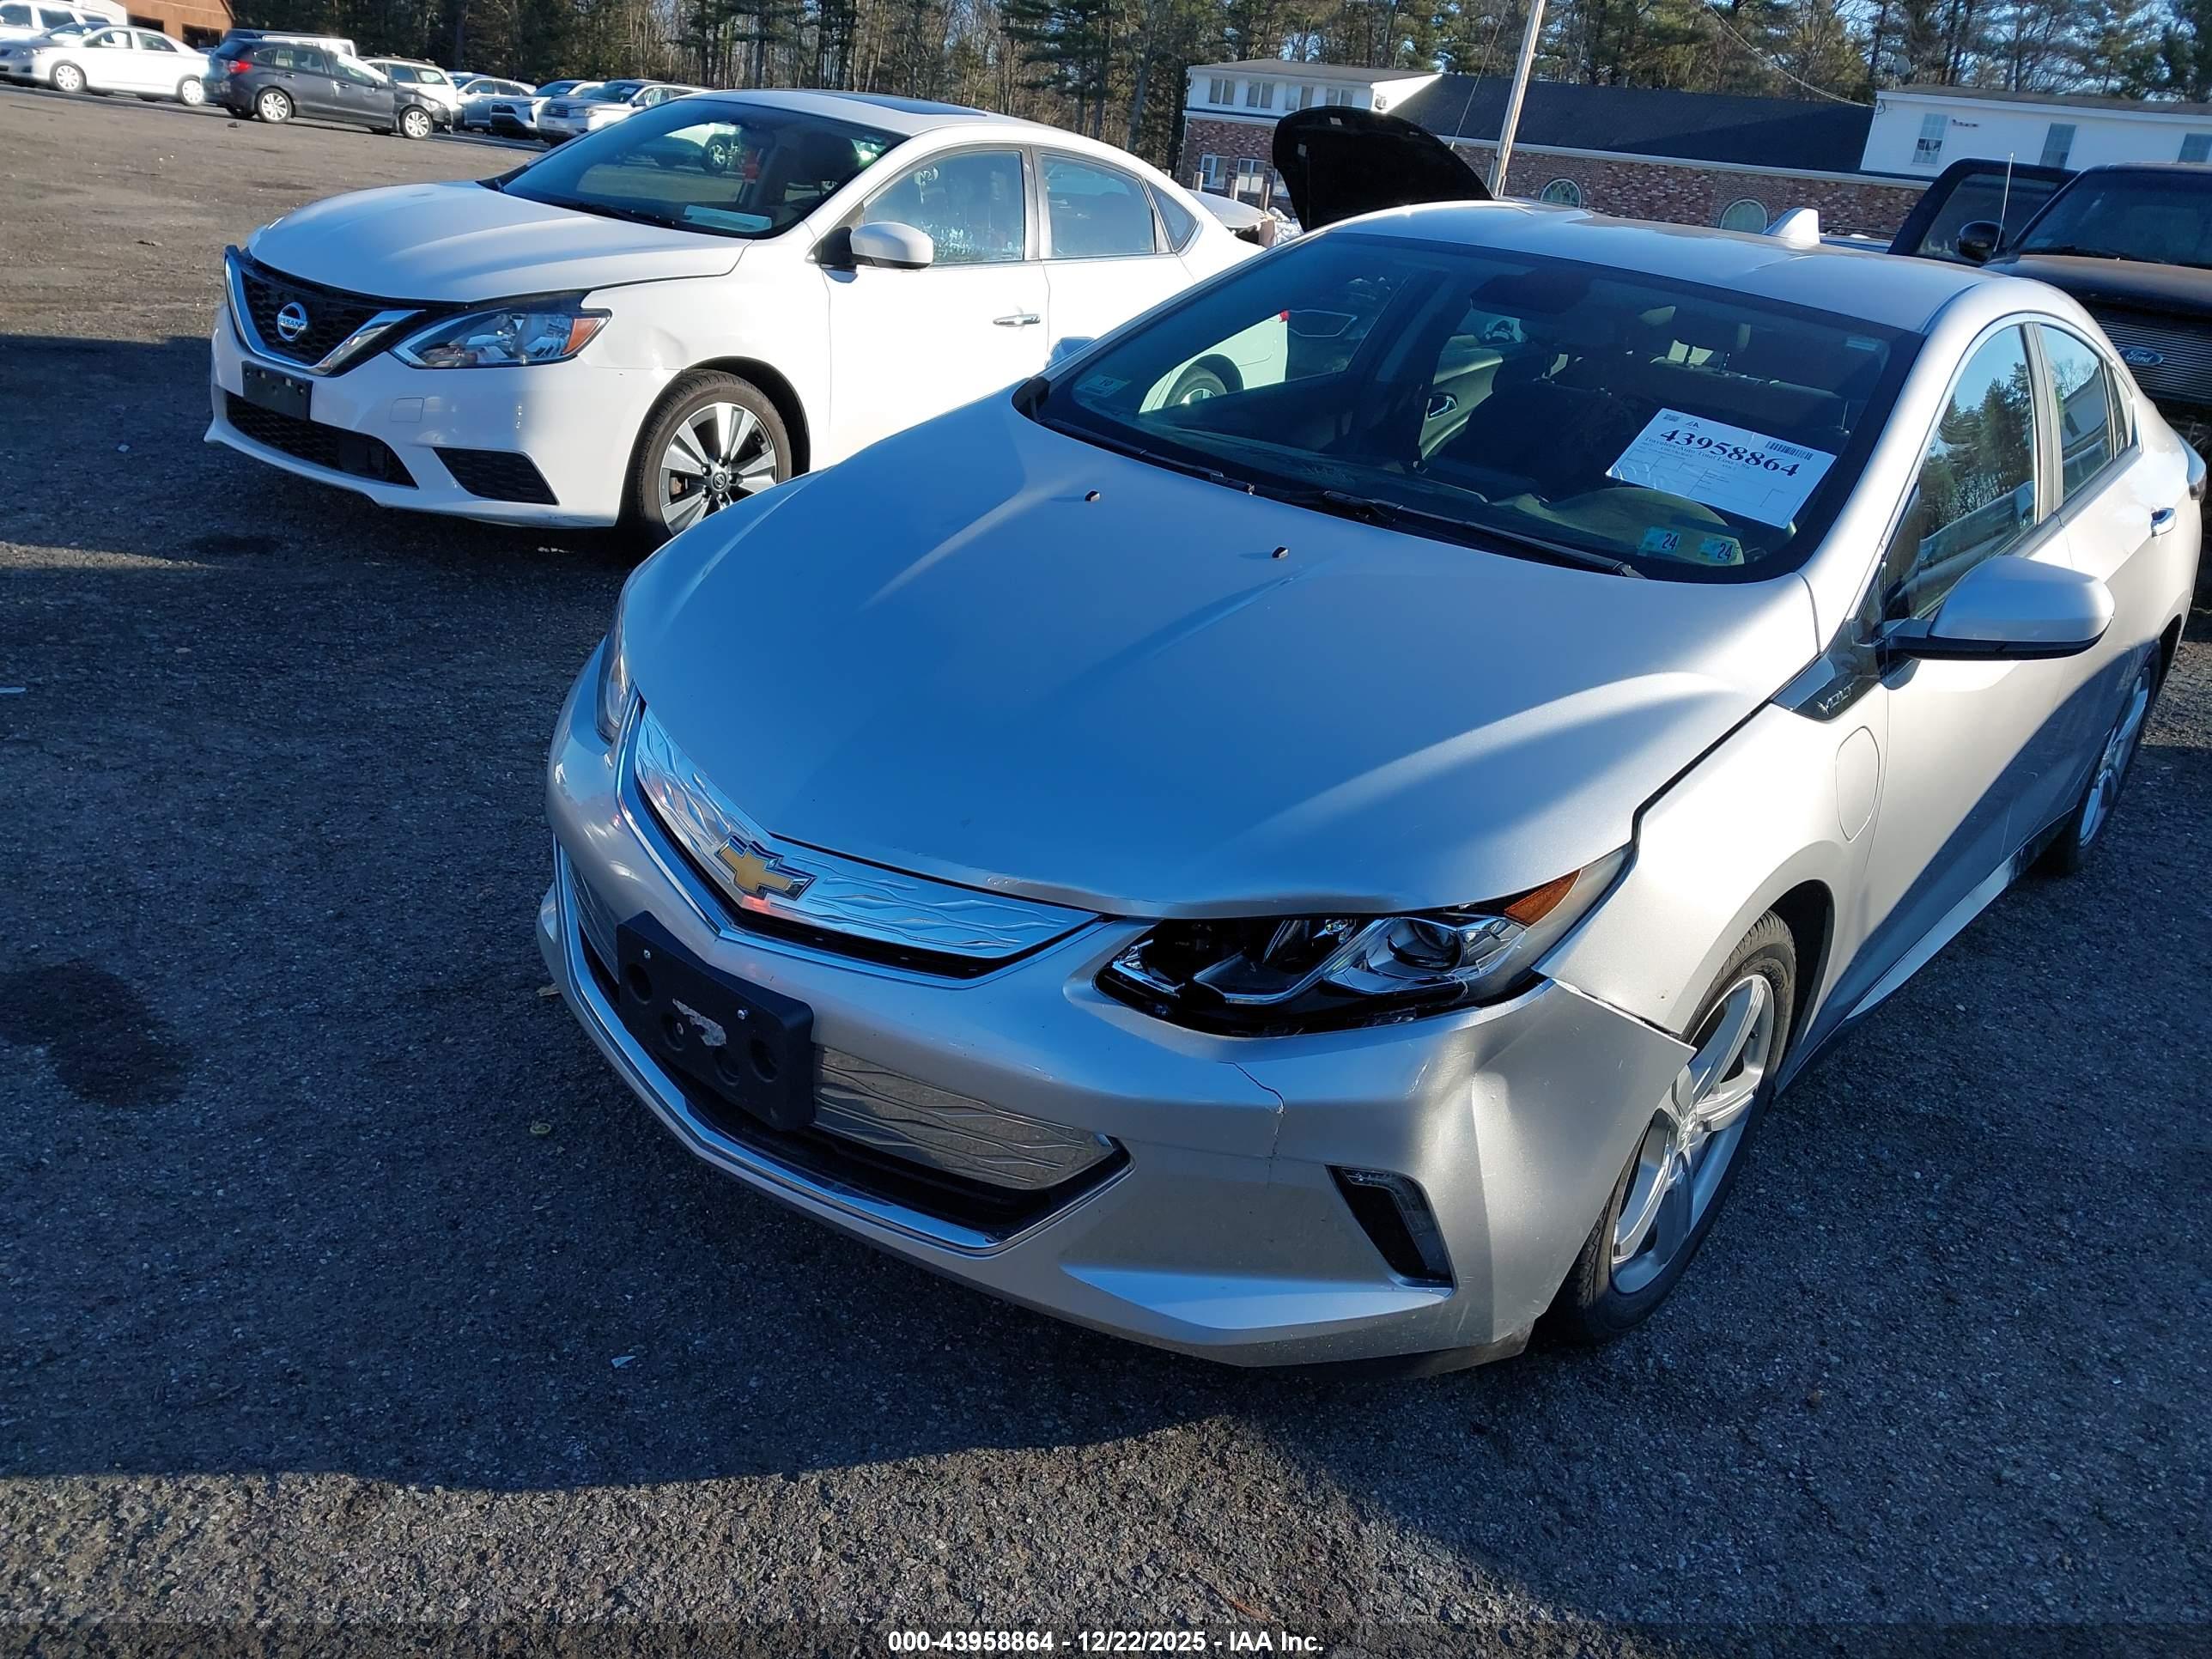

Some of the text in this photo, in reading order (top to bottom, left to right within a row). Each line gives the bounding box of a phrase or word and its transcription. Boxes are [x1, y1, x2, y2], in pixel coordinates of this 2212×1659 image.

[2125, 349, 2154, 363] Ford
[1660, 428, 1801, 477] 43958864
[1662, 532, 1680, 550] 24
[1717, 543, 1734, 561] 24
